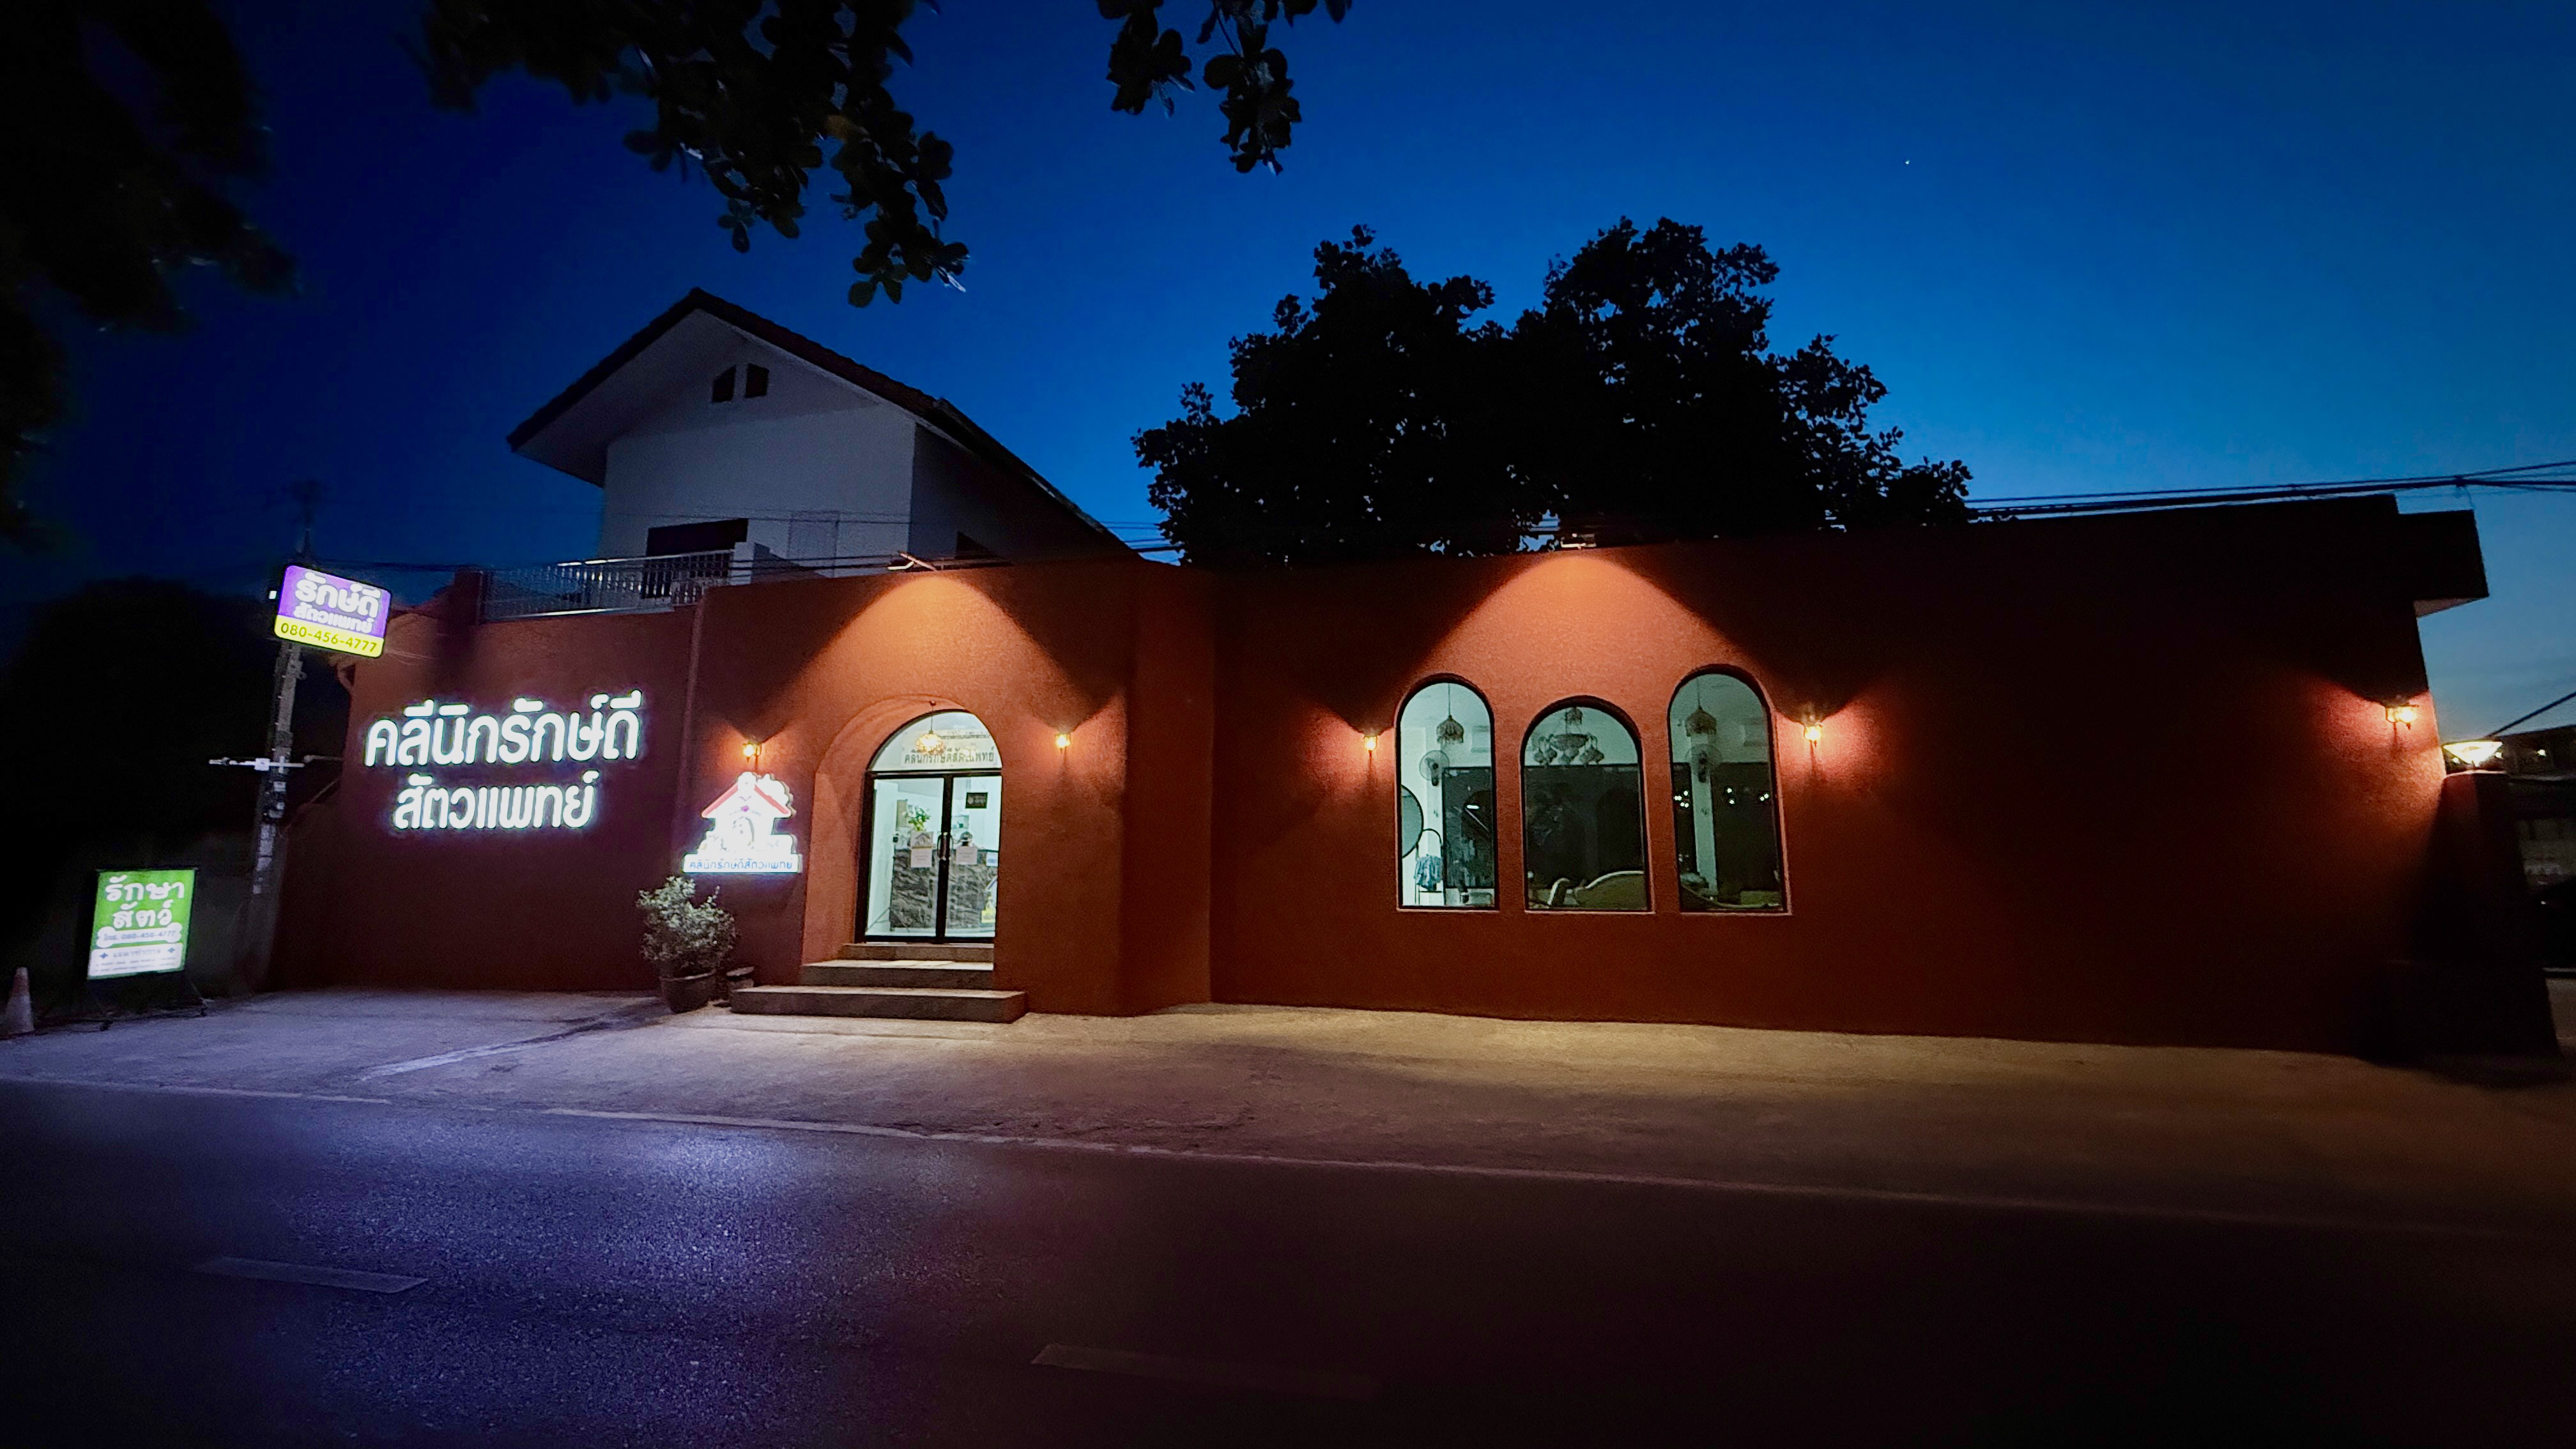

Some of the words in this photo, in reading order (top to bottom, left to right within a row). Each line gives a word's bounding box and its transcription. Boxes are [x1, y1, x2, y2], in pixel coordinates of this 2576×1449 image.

[295, 571, 381, 618] รักษ์ดี
[293, 601, 375, 634] สัตวแพทย์
[280, 622, 378, 653] 080-456-4777
[365, 689, 642, 767] คลีนิกรักษ์ดี
[394, 770, 600, 829] สัตวแพทย์
[105, 874, 185, 901] รักษา
[112, 899, 174, 929] สัตว์
